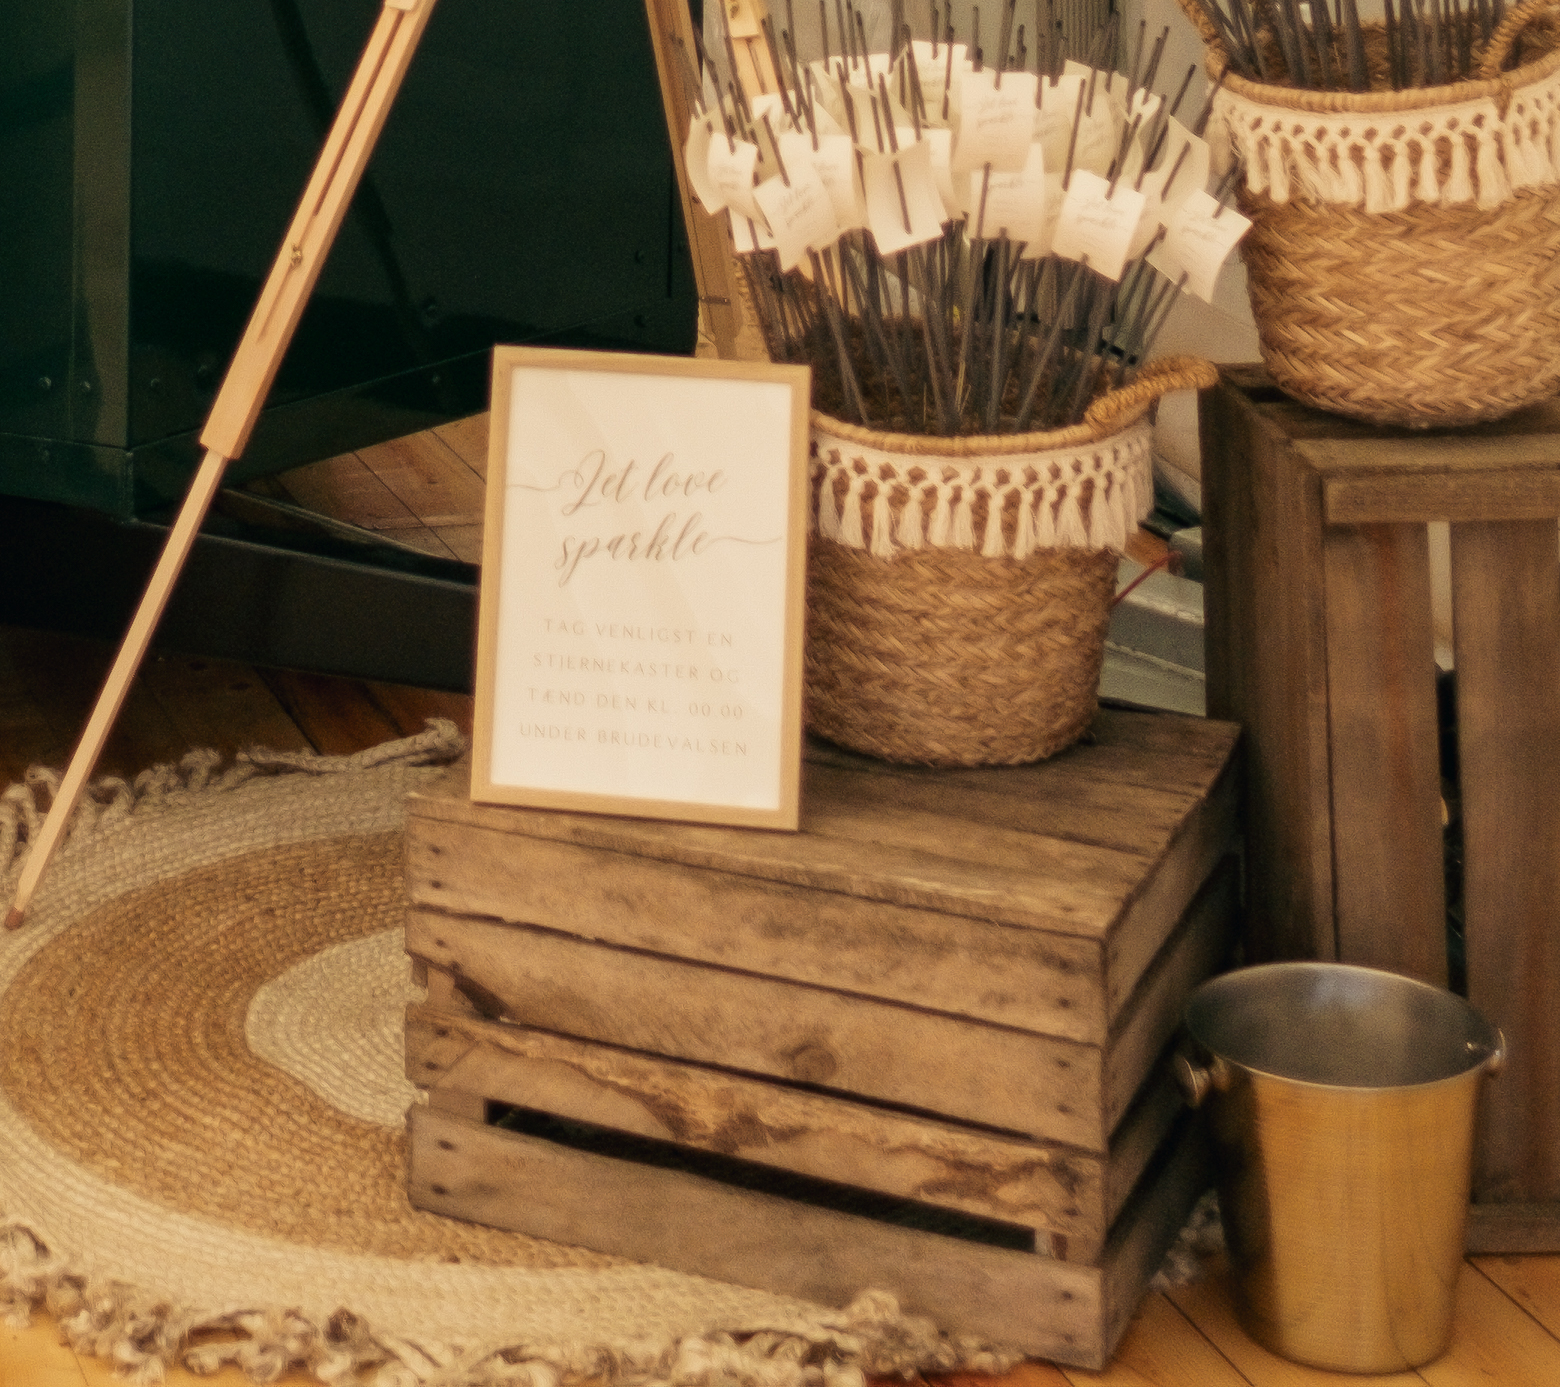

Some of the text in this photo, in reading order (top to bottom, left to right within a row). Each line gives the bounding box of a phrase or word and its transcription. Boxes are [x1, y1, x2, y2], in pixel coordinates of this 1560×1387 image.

[520, 448, 727, 517] Let love
[553, 511, 765, 588] sparkle
[542, 617, 734, 648] TAG VENLIGST EN
[518, 723, 749, 757] UNDER BRUDEVALSEN
